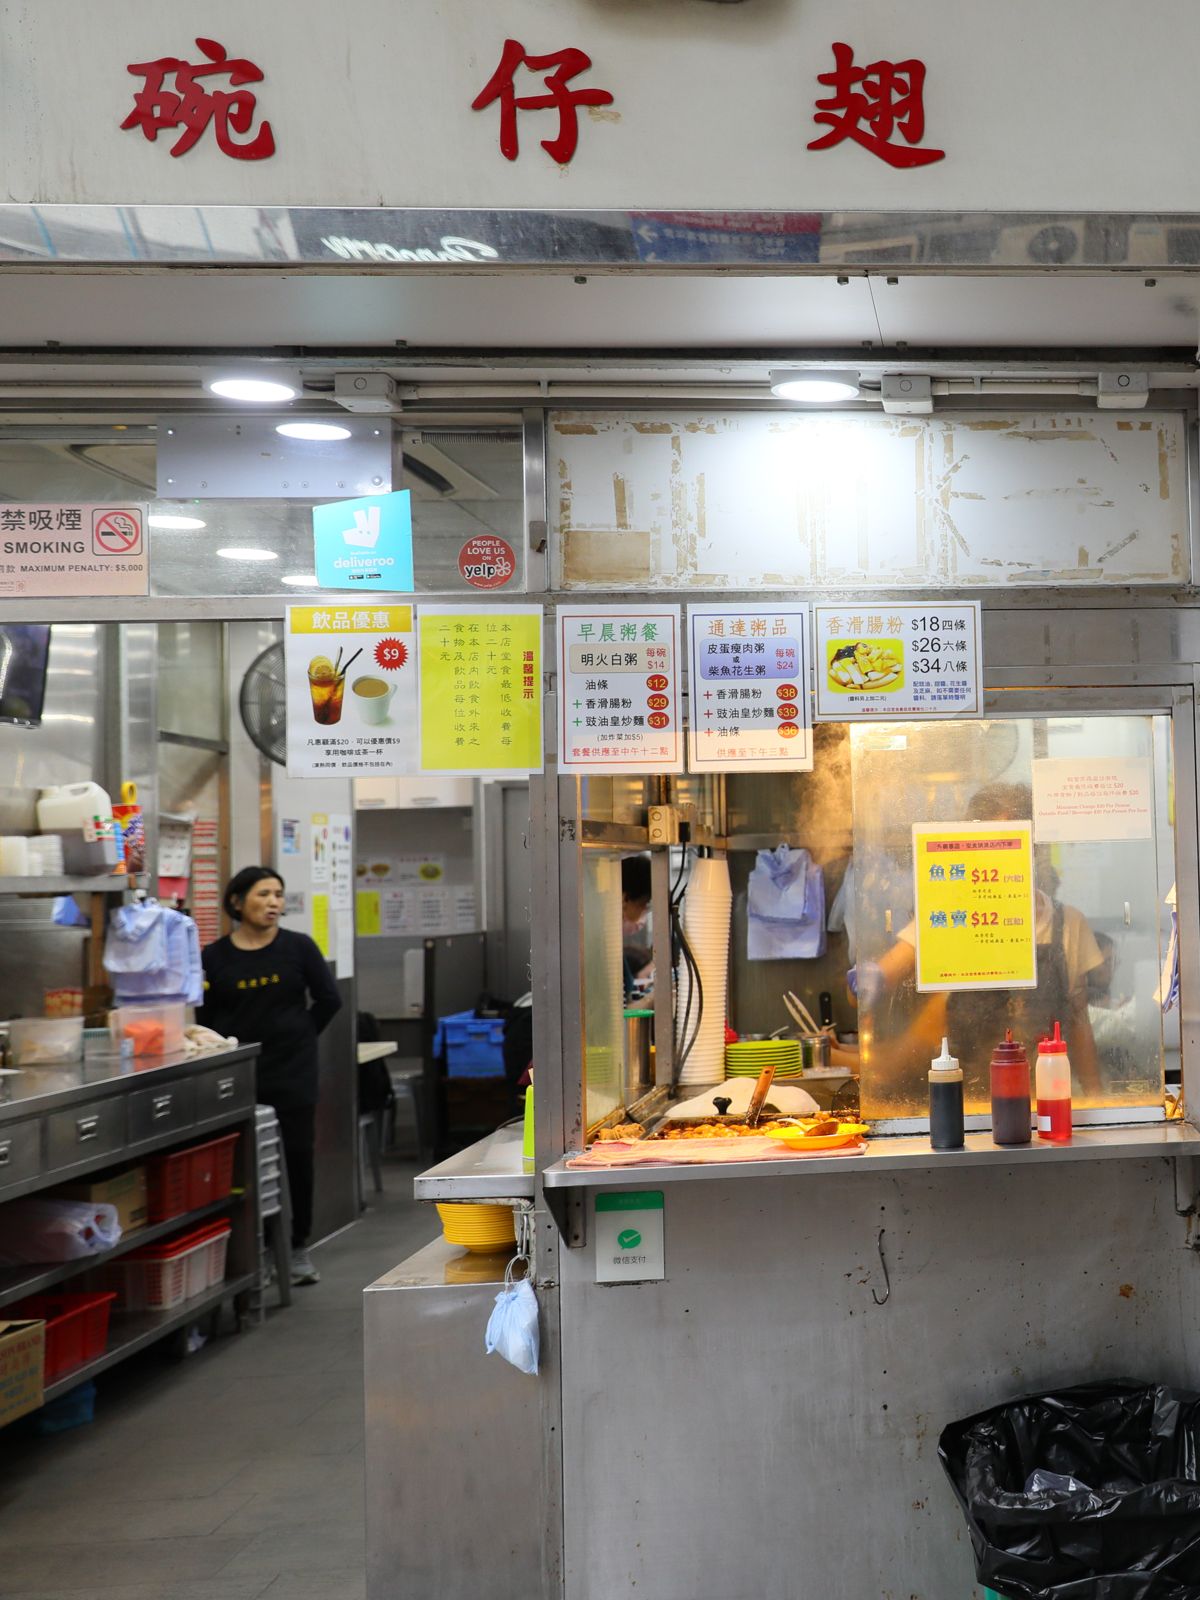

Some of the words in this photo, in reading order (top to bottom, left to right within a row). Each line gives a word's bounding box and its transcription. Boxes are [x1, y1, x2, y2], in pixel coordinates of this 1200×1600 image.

[1, 509, 82, 531] 禁吸煙
[4, 541, 85, 554] SMOKING
[467, 547, 492, 555] LOVE
[493, 547, 506, 555] US
[334, 555, 395, 569] deliveroo
[20, 565, 65, 573] MAXIMUM
[115, 564, 143, 572] $5,000
[464, 563, 496, 580] yelp
[312, 611, 390, 629] 飲品優惠
[826, 615, 904, 635] 香滑腸粉
[911, 616, 940, 632] $18
[577, 622, 660, 642] 早晨粥餐
[708, 618, 787, 637] 通達粥品
[708, 643, 765, 654] 皮蛋瘦肉粥
[911, 637, 941, 653] $26
[383, 648, 399, 660] $9
[646, 648, 667, 658] 每碗
[776, 648, 795, 658] 每碗
[581, 653, 638, 666] 明火白粥
[647, 661, 665, 670] $14
[732, 656, 740, 664] 或
[776, 661, 793, 670] $24
[708, 665, 766, 676] 柴魚花生粥
[912, 658, 941, 674] $34
[585, 679, 608, 690] 油條
[647, 679, 666, 688] $12
[716, 688, 762, 700] 香滑腸粉
[777, 688, 796, 698] $38
[585, 698, 632, 709] 香滑腸粉
[648, 697, 667, 708] $29
[778, 707, 796, 717] $39
[648, 716, 666, 726] $31
[717, 726, 740, 737] 油條
[779, 726, 797, 736] $36
[928, 863, 967, 882] 魚蛋
[971, 868, 999, 885] $12
[929, 909, 968, 929] 燒賣
[971, 911, 999, 928] $12
[613, 1255, 646, 1265] 微信支付
